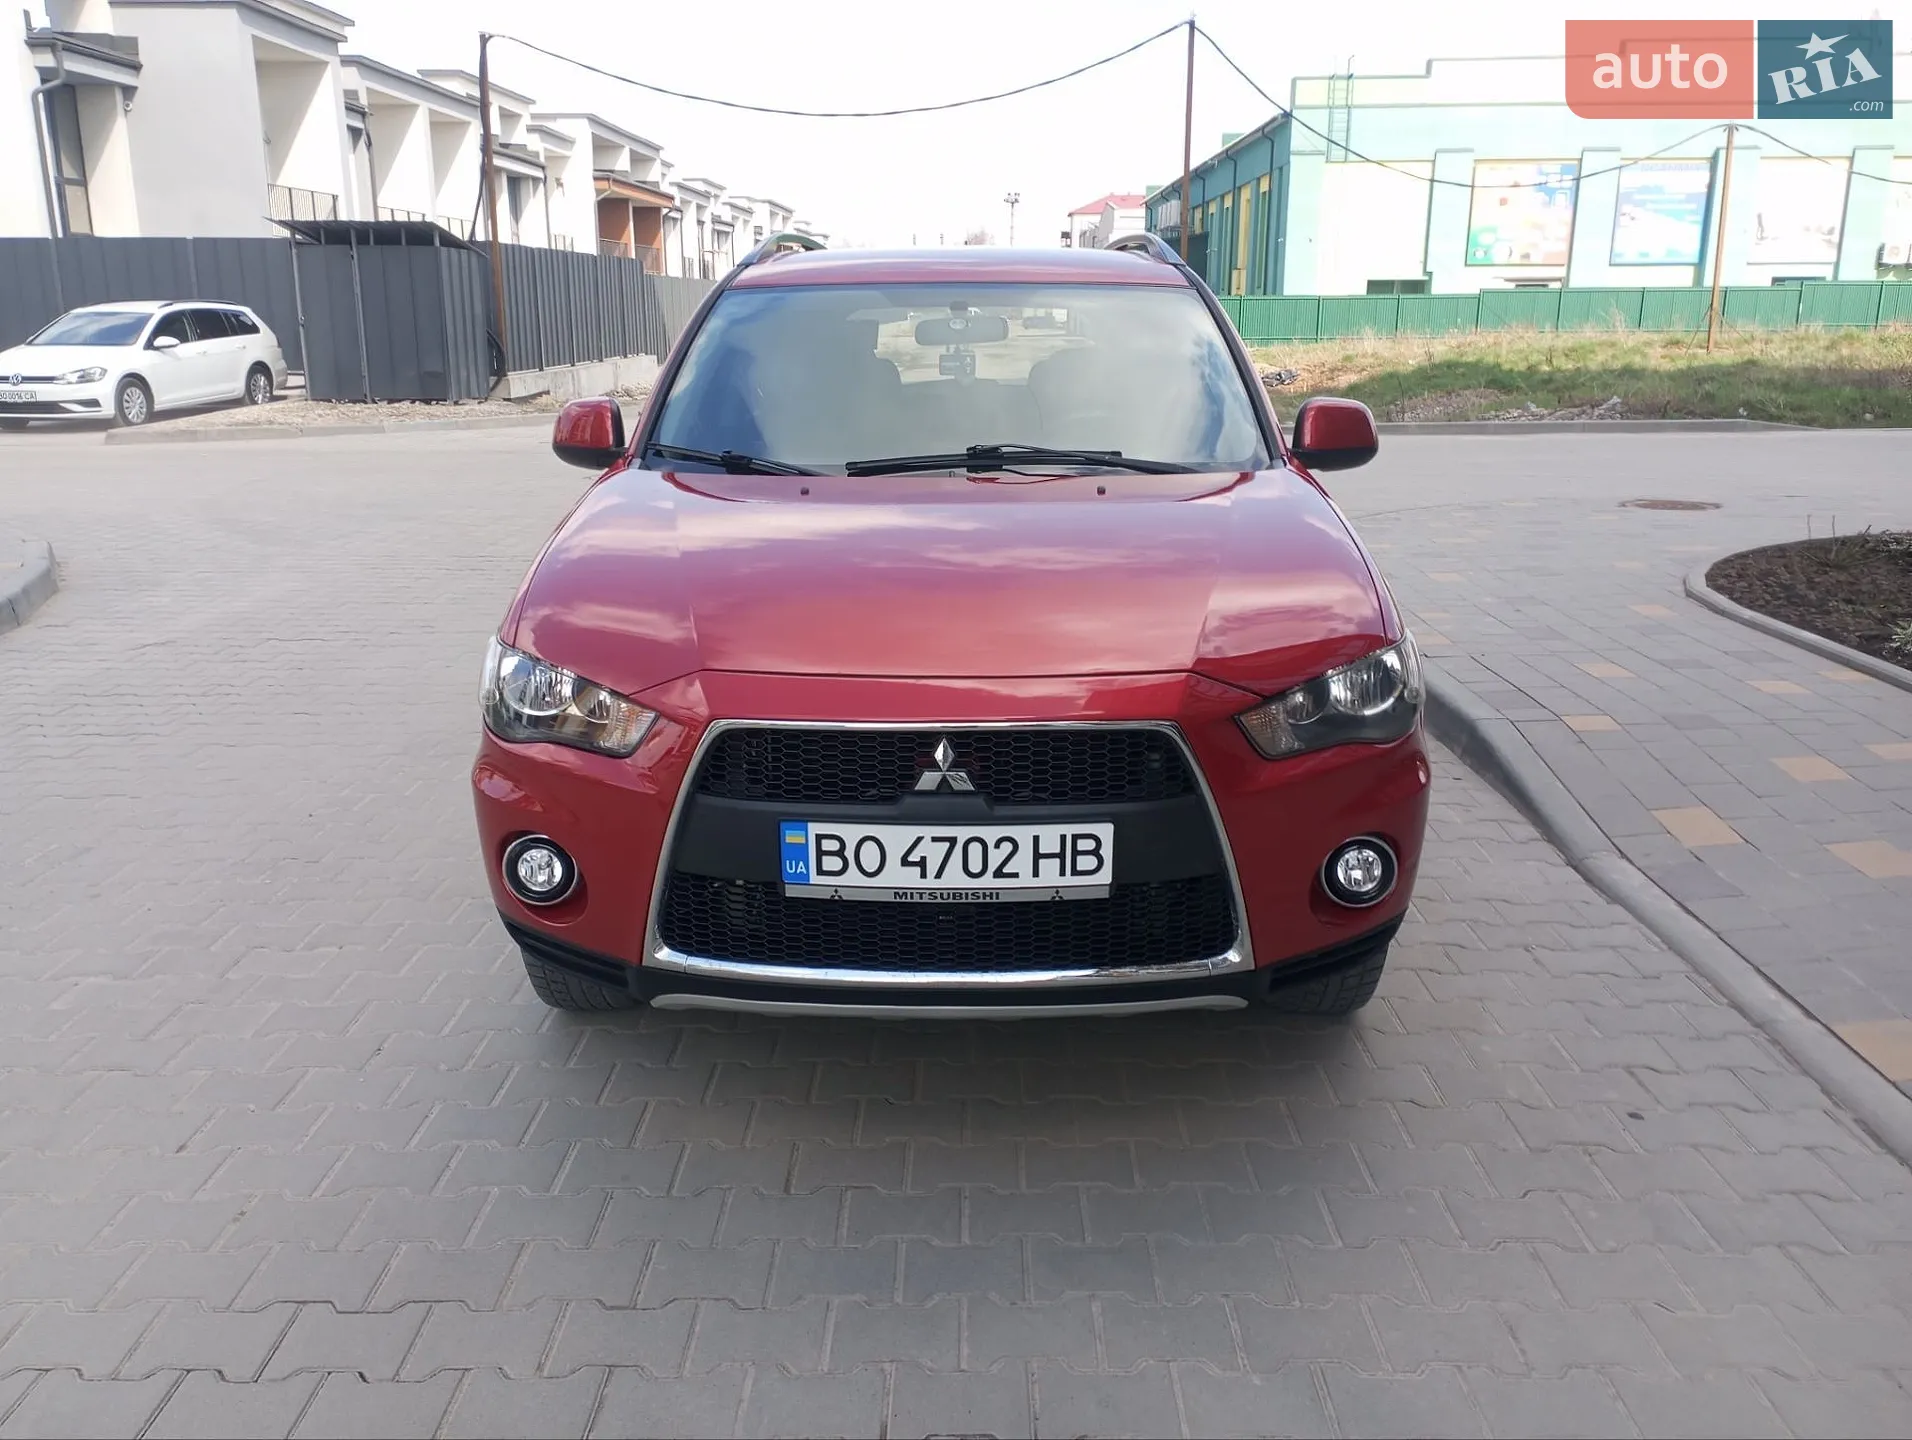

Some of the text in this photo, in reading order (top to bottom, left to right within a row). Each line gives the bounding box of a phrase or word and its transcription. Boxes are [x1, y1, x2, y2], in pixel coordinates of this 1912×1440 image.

[24, 391, 35, 400] CA
[814, 832, 1105, 880] BO 4702 HB
[786, 859, 807, 875] UA
[893, 891, 1000, 901] MITSUBISHI
